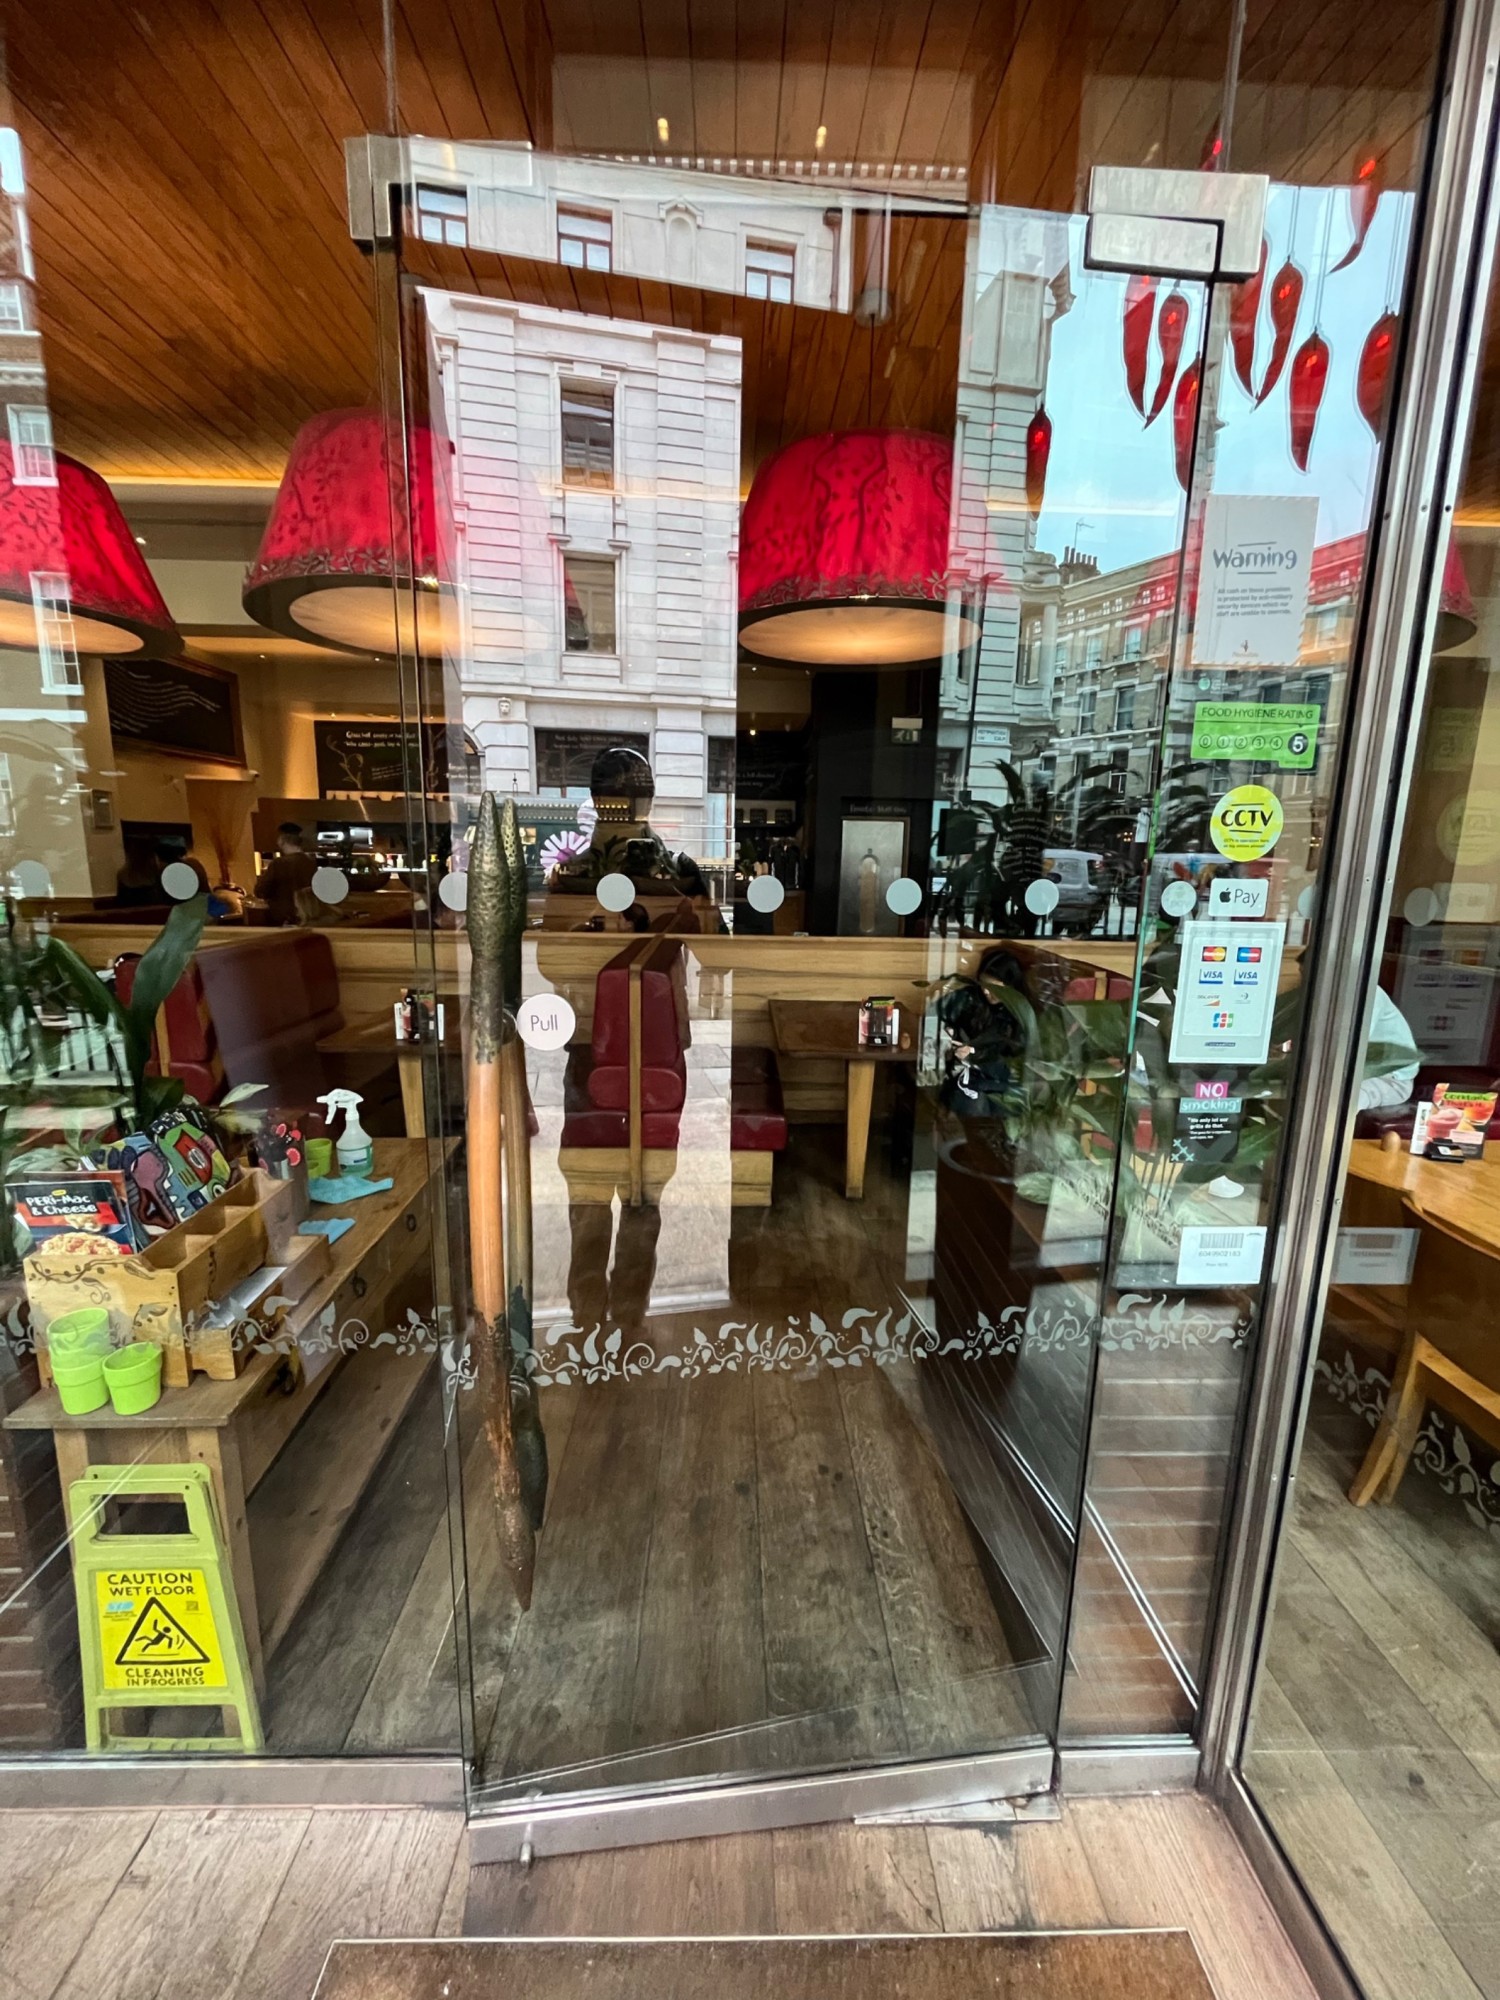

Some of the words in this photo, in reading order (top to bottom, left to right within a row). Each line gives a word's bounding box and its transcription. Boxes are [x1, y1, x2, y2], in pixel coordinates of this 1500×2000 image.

[1213, 547, 1297, 570] Warning
[1201, 707, 1232, 718] FOOD
[1233, 708, 1277, 719] HYGIENE
[1278, 709, 1313, 720] RATING
[1220, 809, 1273, 827] CCTV
[1234, 889, 1260, 908] Pay
[1203, 970, 1223, 980] VISA
[1237, 971, 1258, 981] VISA
[530, 1014, 557, 1031] Pull
[1199, 1083, 1224, 1098] NO
[32, 1206, 42, 1216] &
[43, 1204, 97, 1215] Cheese
[107, 1572, 193, 1585] CAUTION
[110, 1586, 142, 1597] WET
[146, 1585, 196, 1596] FLOOR
[125, 1667, 204, 1679] CLEANING
[127, 1678, 140, 1686] IN
[143, 1677, 205, 1686] PROGRESS
